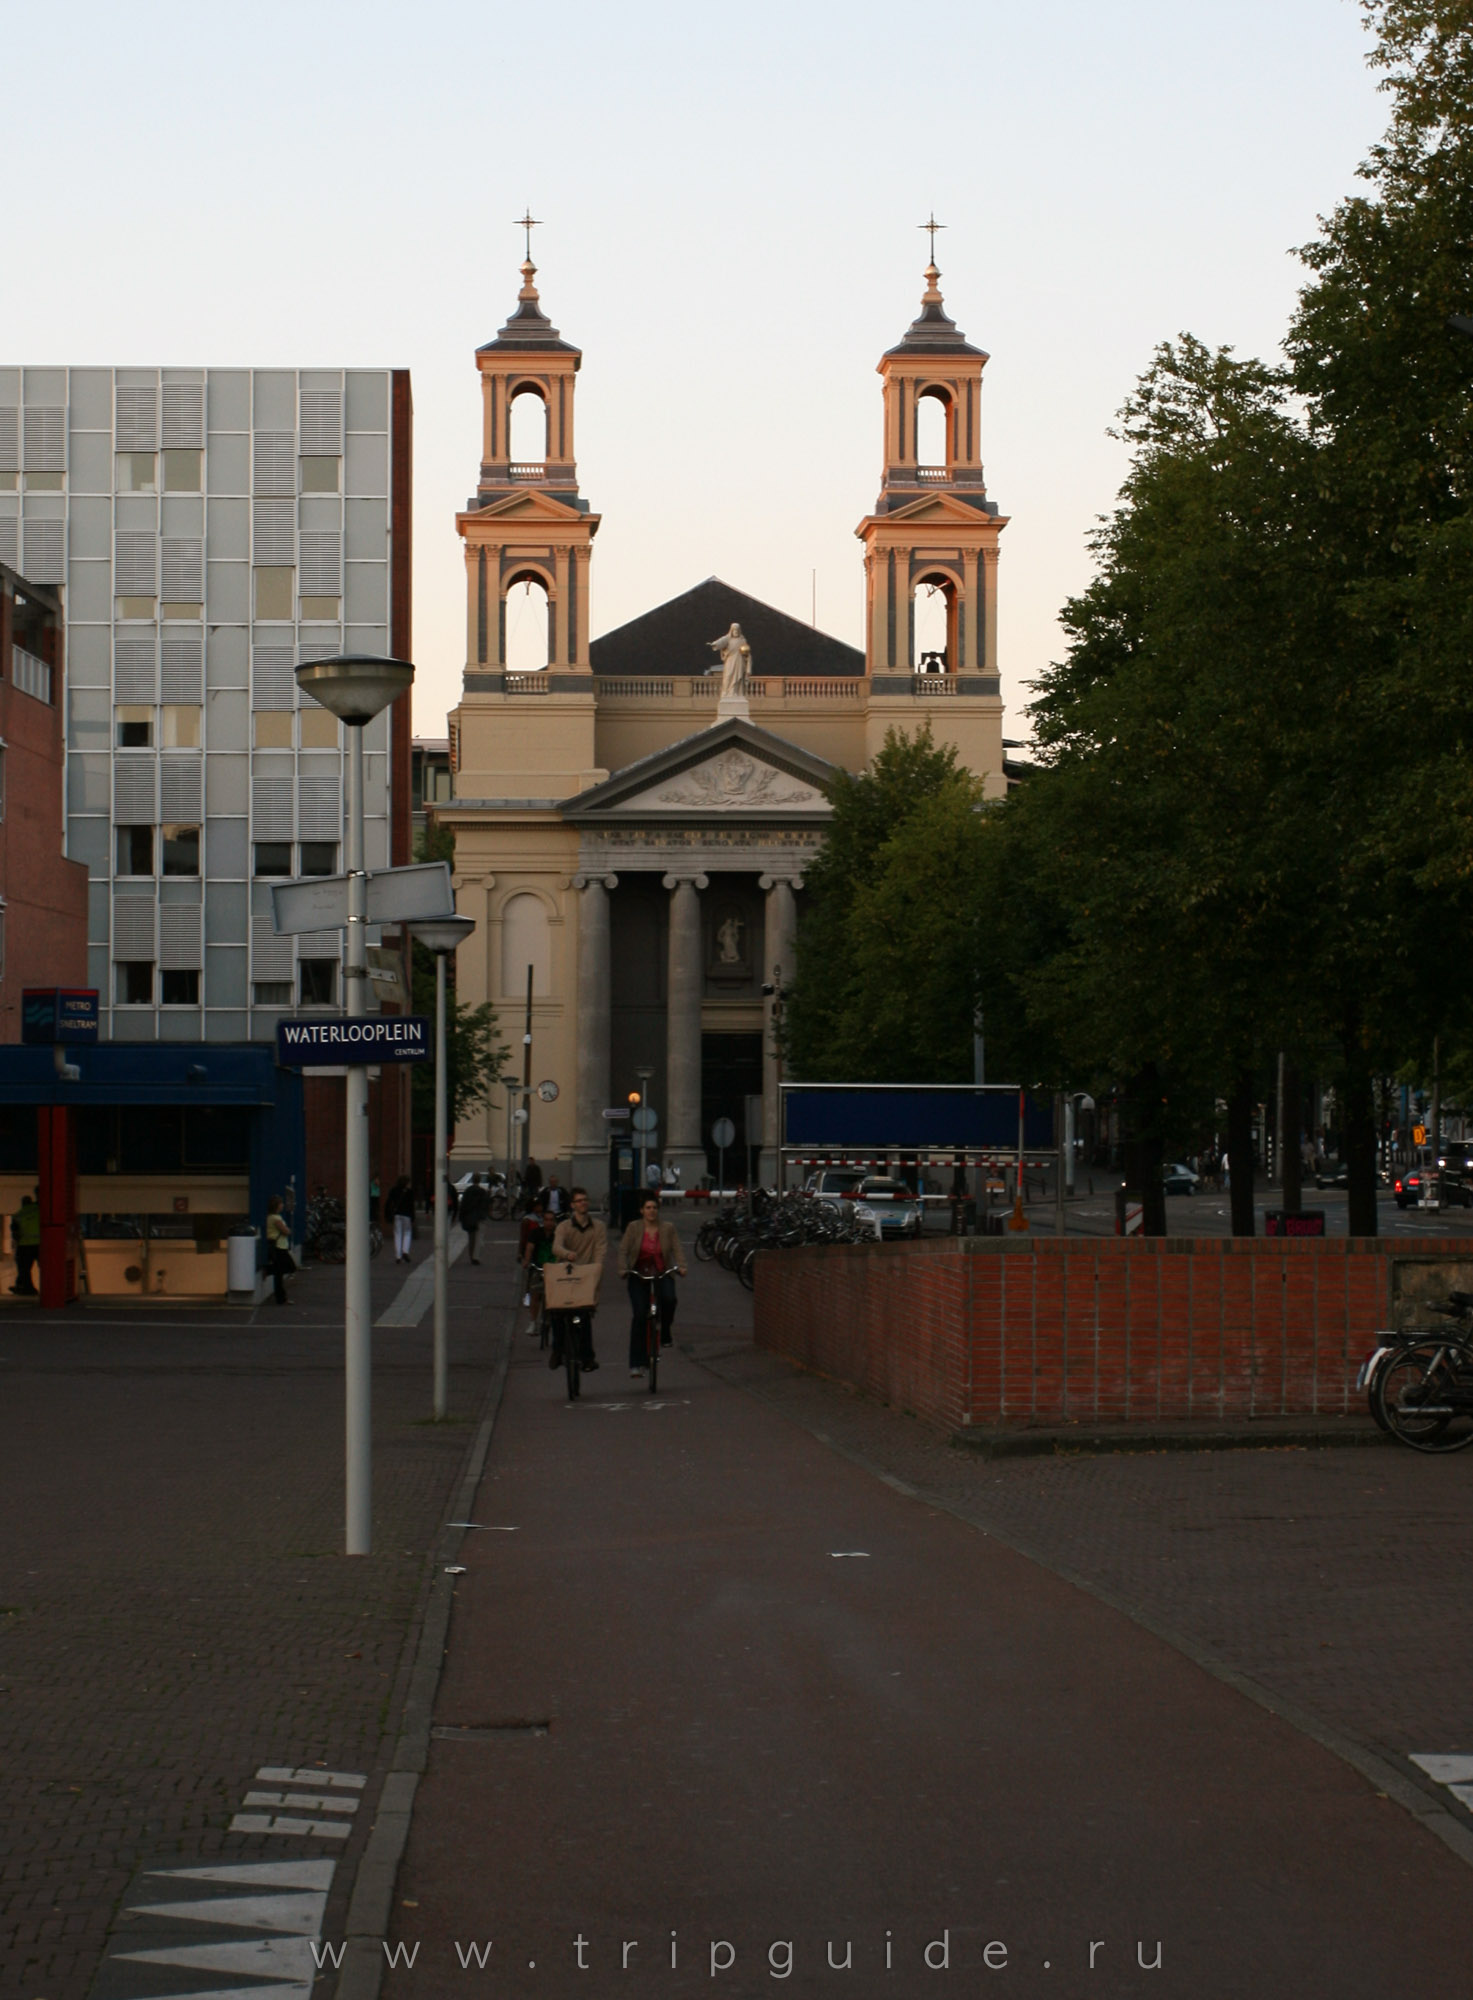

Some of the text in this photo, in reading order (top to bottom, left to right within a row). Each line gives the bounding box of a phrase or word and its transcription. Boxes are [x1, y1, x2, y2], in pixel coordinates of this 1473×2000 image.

[65, 1000, 92, 1012] METRO
[284, 1023, 422, 1044] WATERLOOPLEIN
[394, 1048, 425, 1056] CENTRUM
